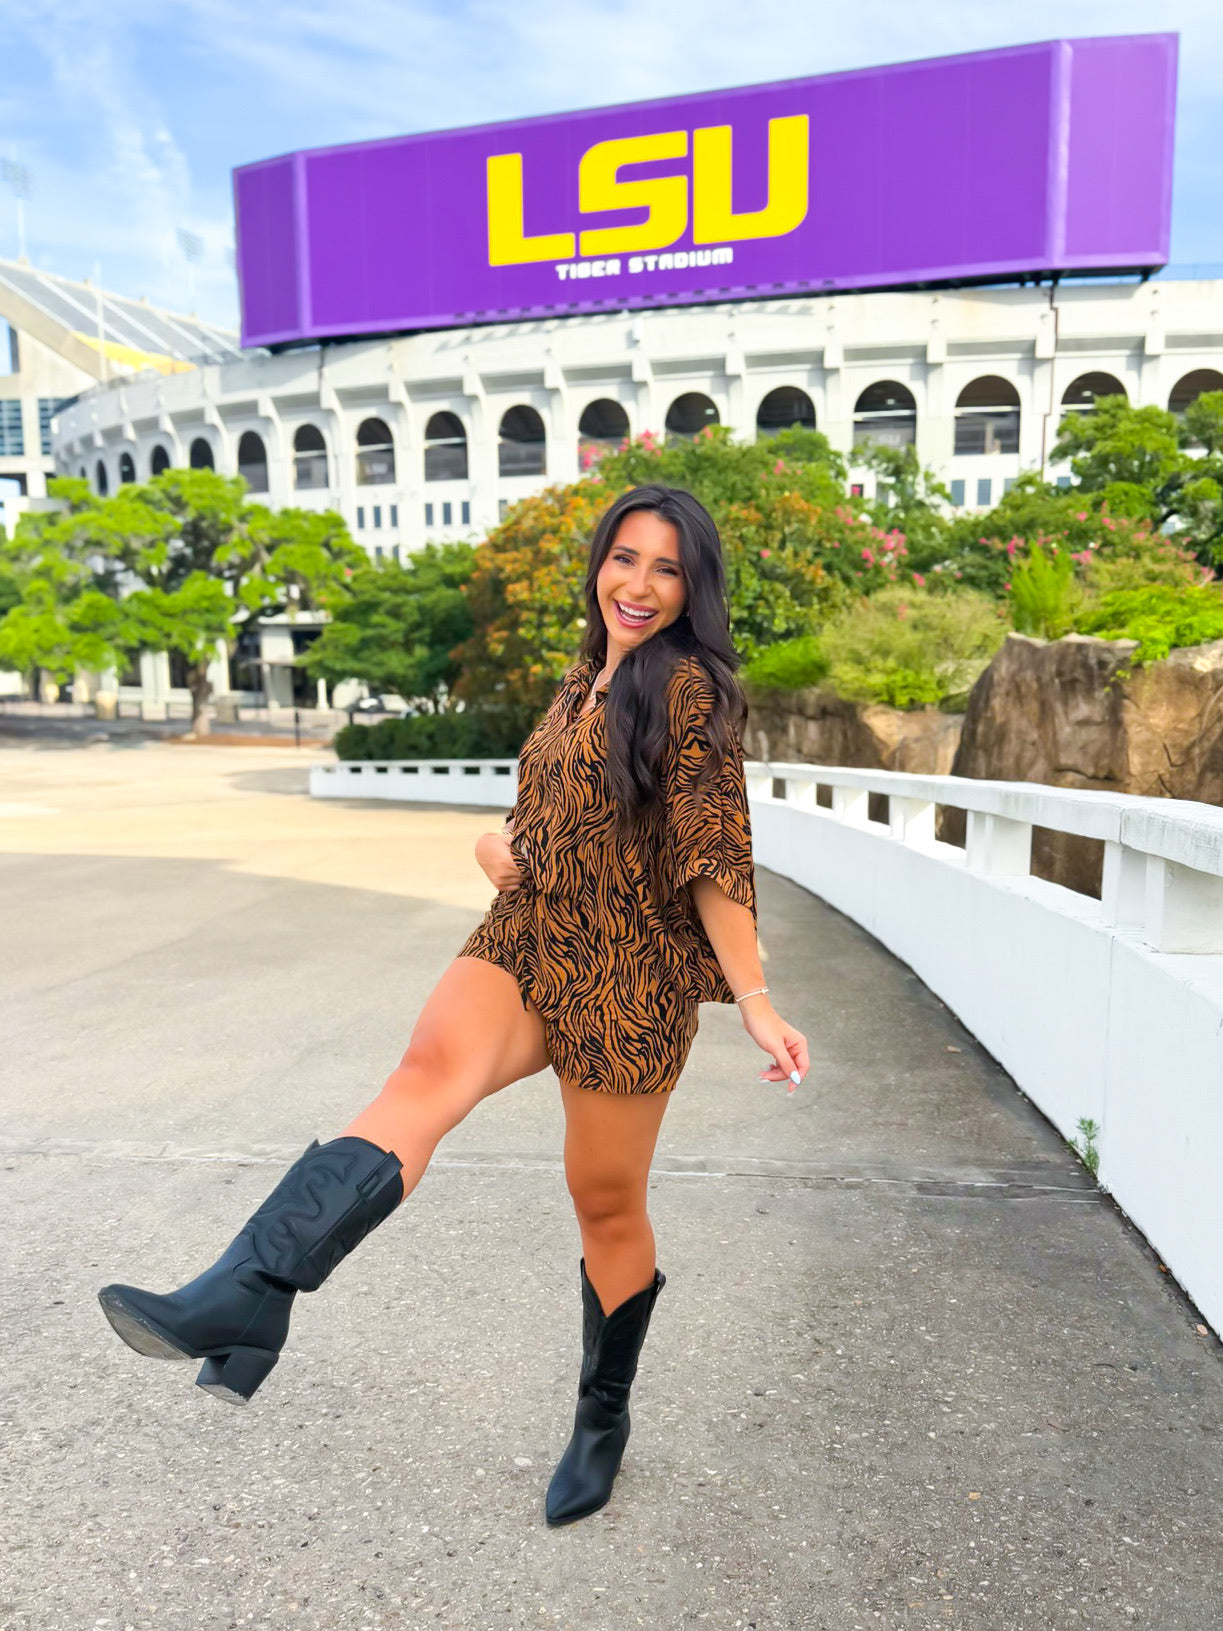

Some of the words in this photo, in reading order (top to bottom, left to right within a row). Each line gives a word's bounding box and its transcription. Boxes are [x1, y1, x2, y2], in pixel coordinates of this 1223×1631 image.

[487, 114, 809, 266] LSU
[555, 259, 621, 280] TIGER
[628, 247, 733, 273] STADIUM
